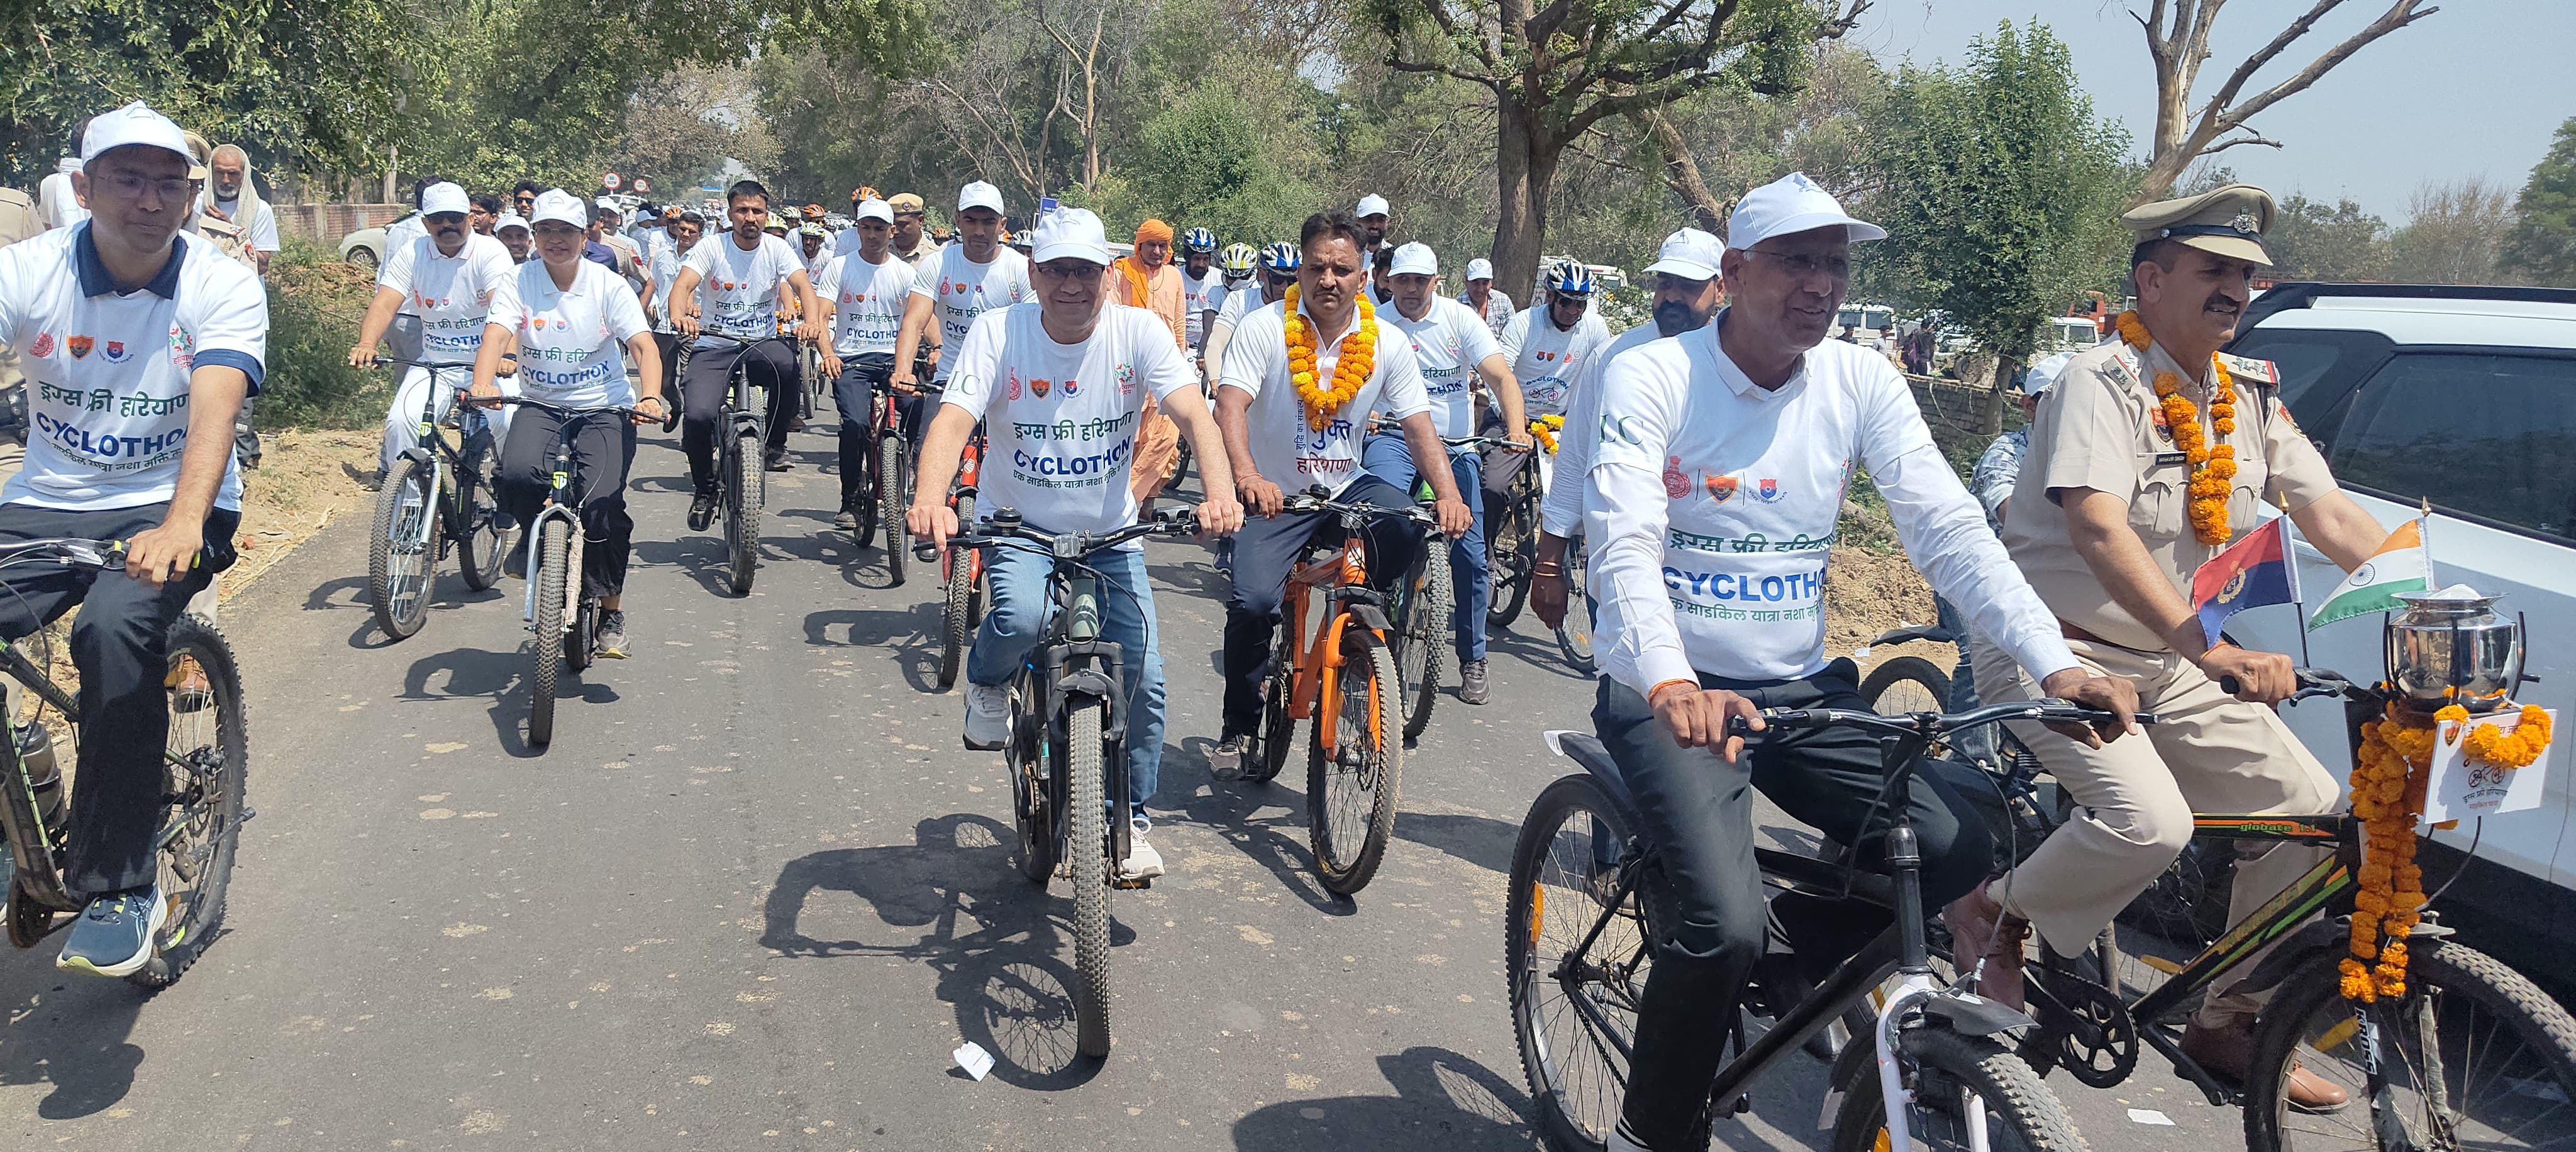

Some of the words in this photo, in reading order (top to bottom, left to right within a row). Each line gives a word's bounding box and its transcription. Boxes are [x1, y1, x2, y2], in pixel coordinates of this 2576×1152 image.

[714, 312, 773, 328] CYCLOTHON
[425, 334, 483, 346] CYCLOTH
[847, 328, 901, 340] CYCLOTHO
[521, 360, 609, 385] CYCLOTHON
[1421, 365, 1462, 379] हरियाणा
[120, 391, 190, 418] हरियाण
[36, 412, 189, 457] CYCLOTHO
[1051, 419, 1076, 441] फ्री
[1080, 411, 1135, 441] हरियाणा
[1014, 435, 1131, 475] CYCLOTHON
[1296, 451, 1353, 474] हरियाणा
[1013, 470, 1026, 481] एक
[1026, 475, 1062, 489] साइकिल
[1064, 480, 1084, 489] यात्रा
[1085, 477, 1103, 487] नशा
[1687, 602, 1747, 621] साइकिल
[1750, 610, 1780, 622] यात्रा
[1783, 608, 1805, 621] नशा
